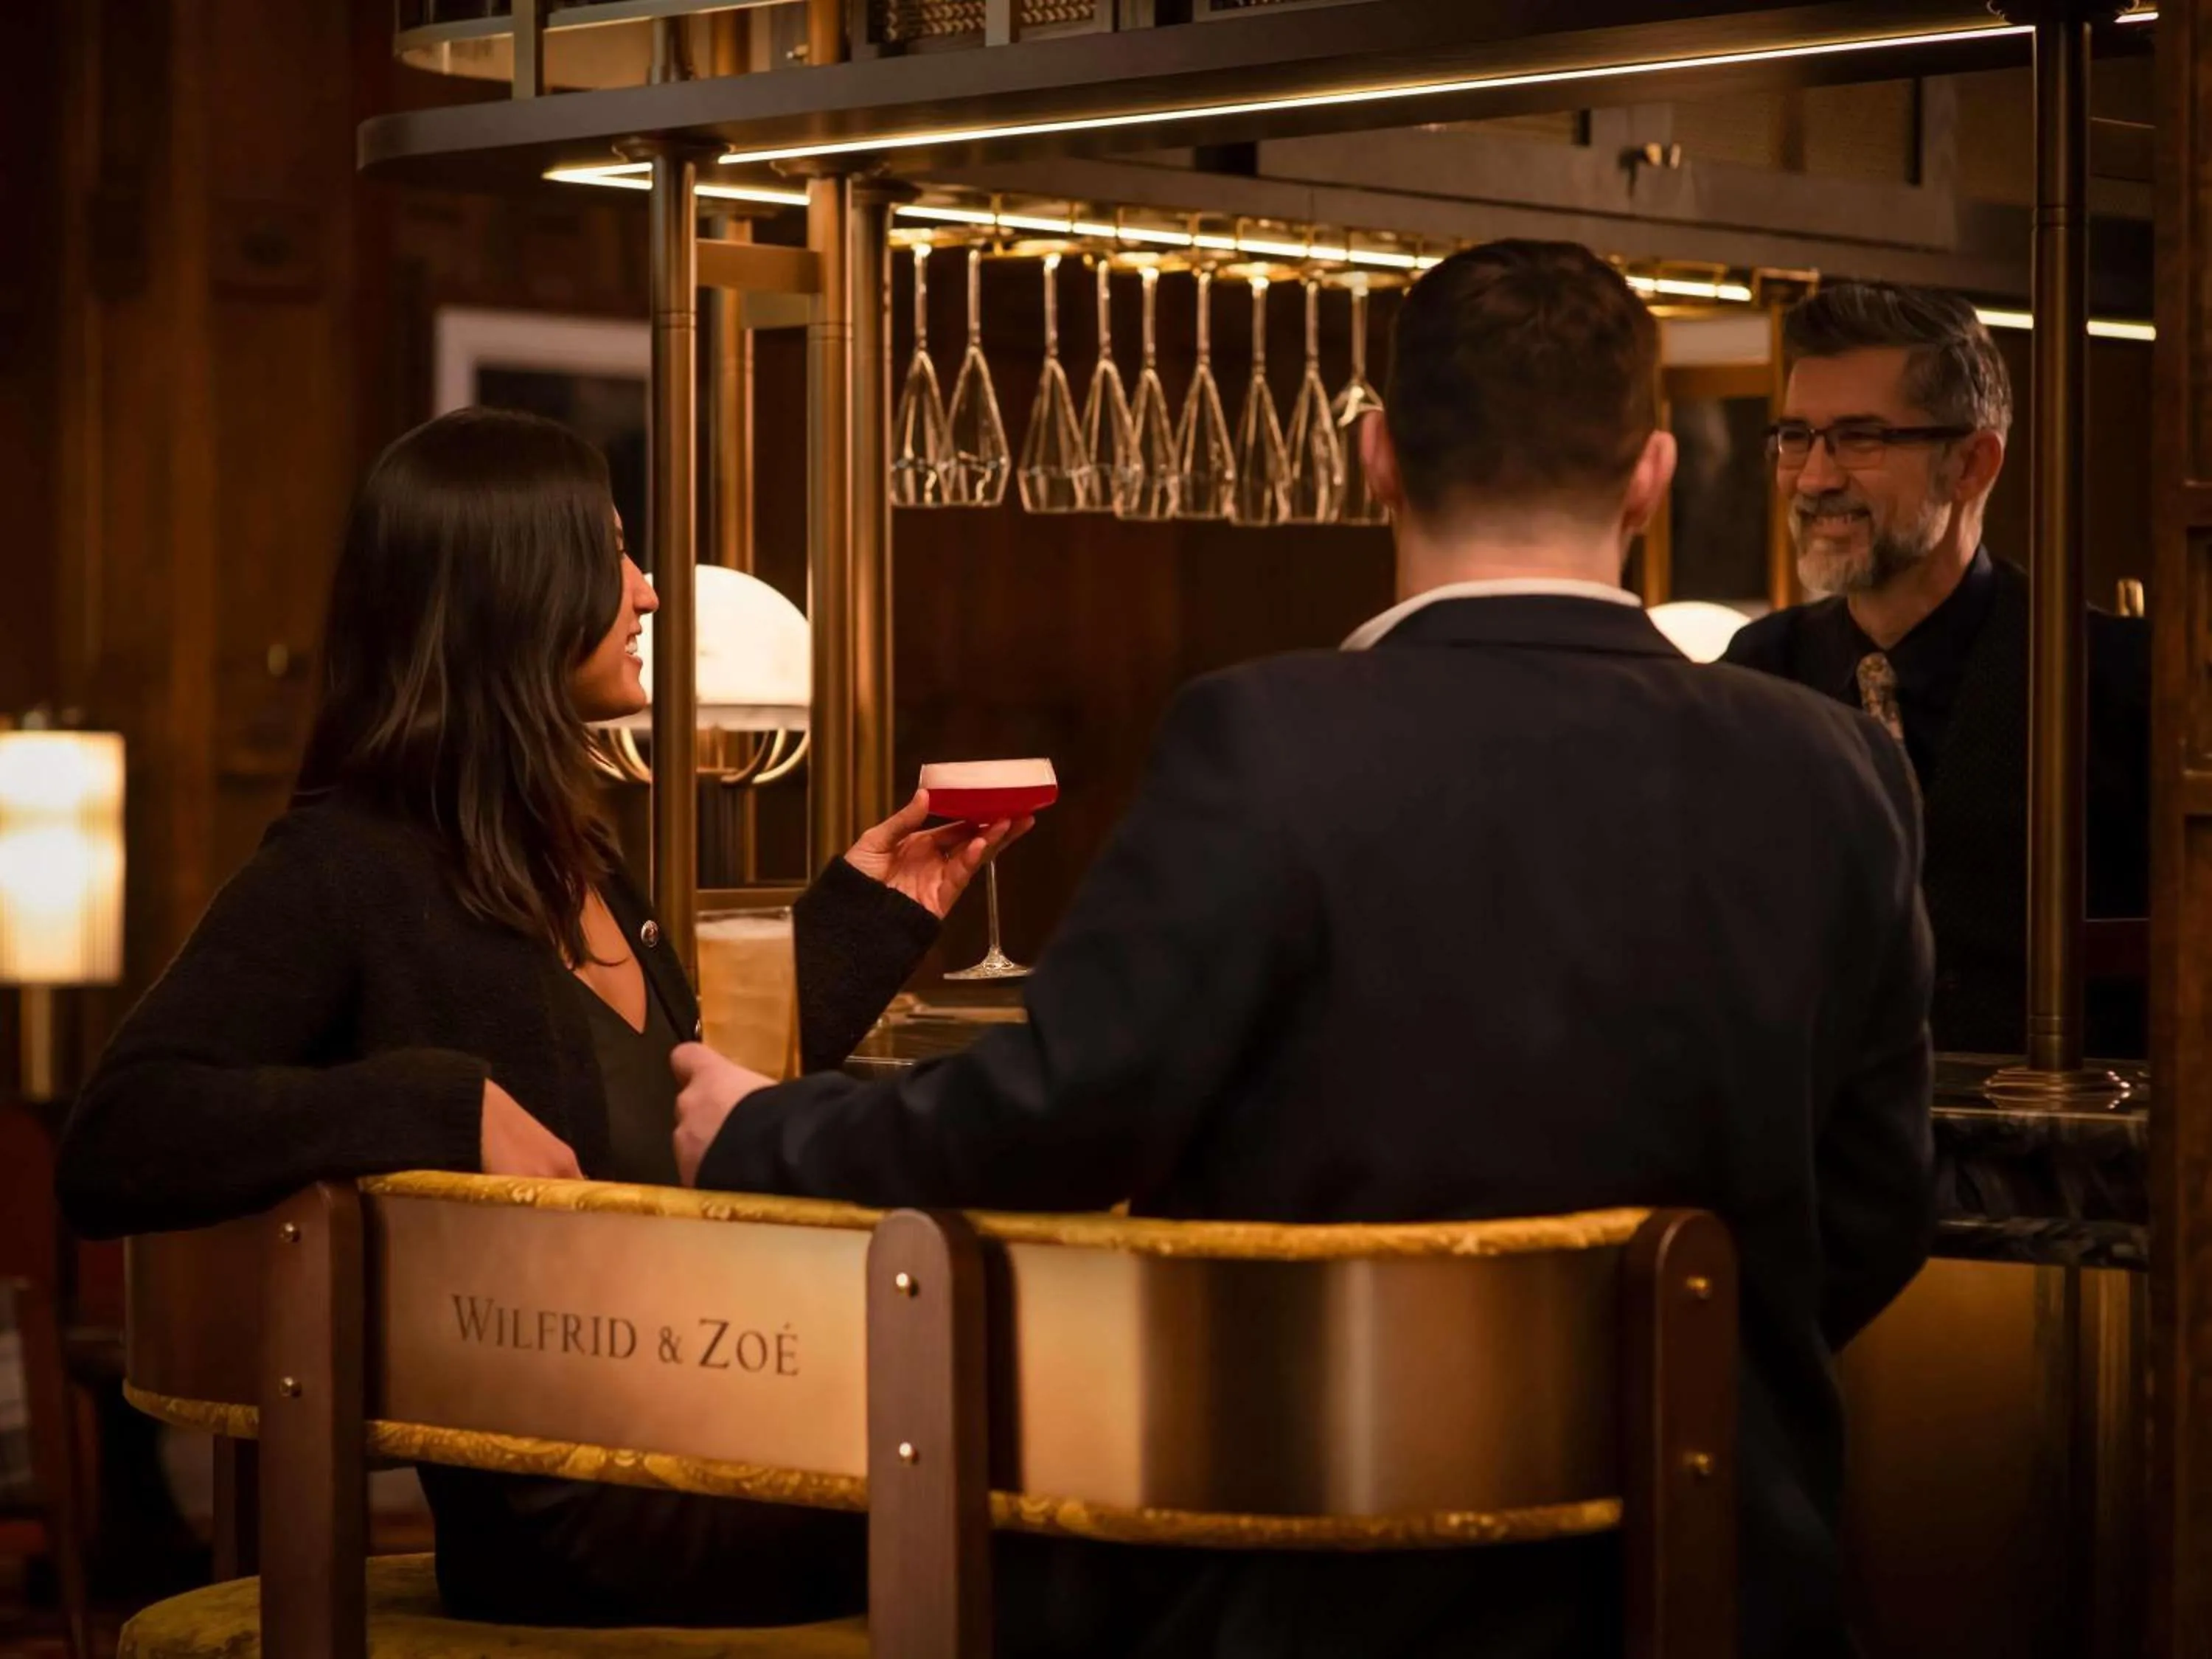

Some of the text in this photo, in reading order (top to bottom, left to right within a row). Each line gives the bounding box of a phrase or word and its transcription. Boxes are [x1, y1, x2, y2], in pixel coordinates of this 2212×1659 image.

[451, 1294, 799, 1377] WILFRID & ZOÉ
